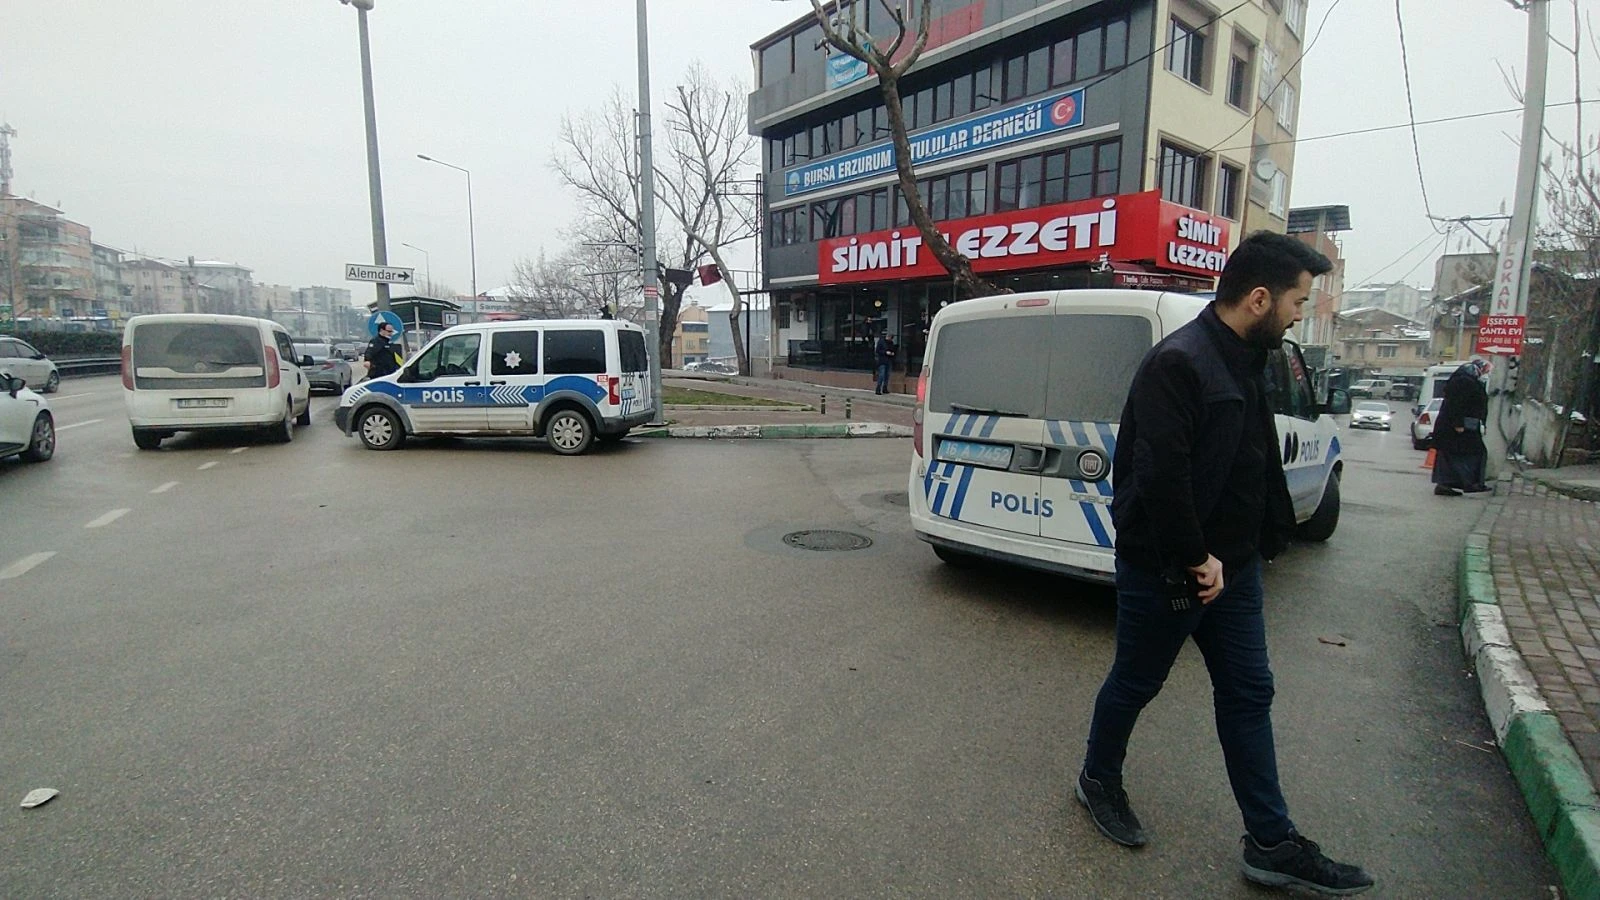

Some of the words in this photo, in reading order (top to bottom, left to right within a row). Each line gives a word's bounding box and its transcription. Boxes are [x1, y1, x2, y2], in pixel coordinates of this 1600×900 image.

[804, 163, 836, 187] BURSA
[838, 149, 892, 178] ERZURUM
[972, 103, 1042, 146] DERNEĞİ
[1178, 213, 1221, 246] SİMİT
[832, 231, 922, 272] SİMİT
[348, 267, 397, 281] Alemdar
[422, 387, 465, 403] POLİS
[945, 441, 958, 456] 16
[961, 445, 970, 456] A
[1300, 434, 1320, 462] POLİS
[1084, 458, 1098, 471] FIAT
[990, 491, 1054, 518] POLİS
